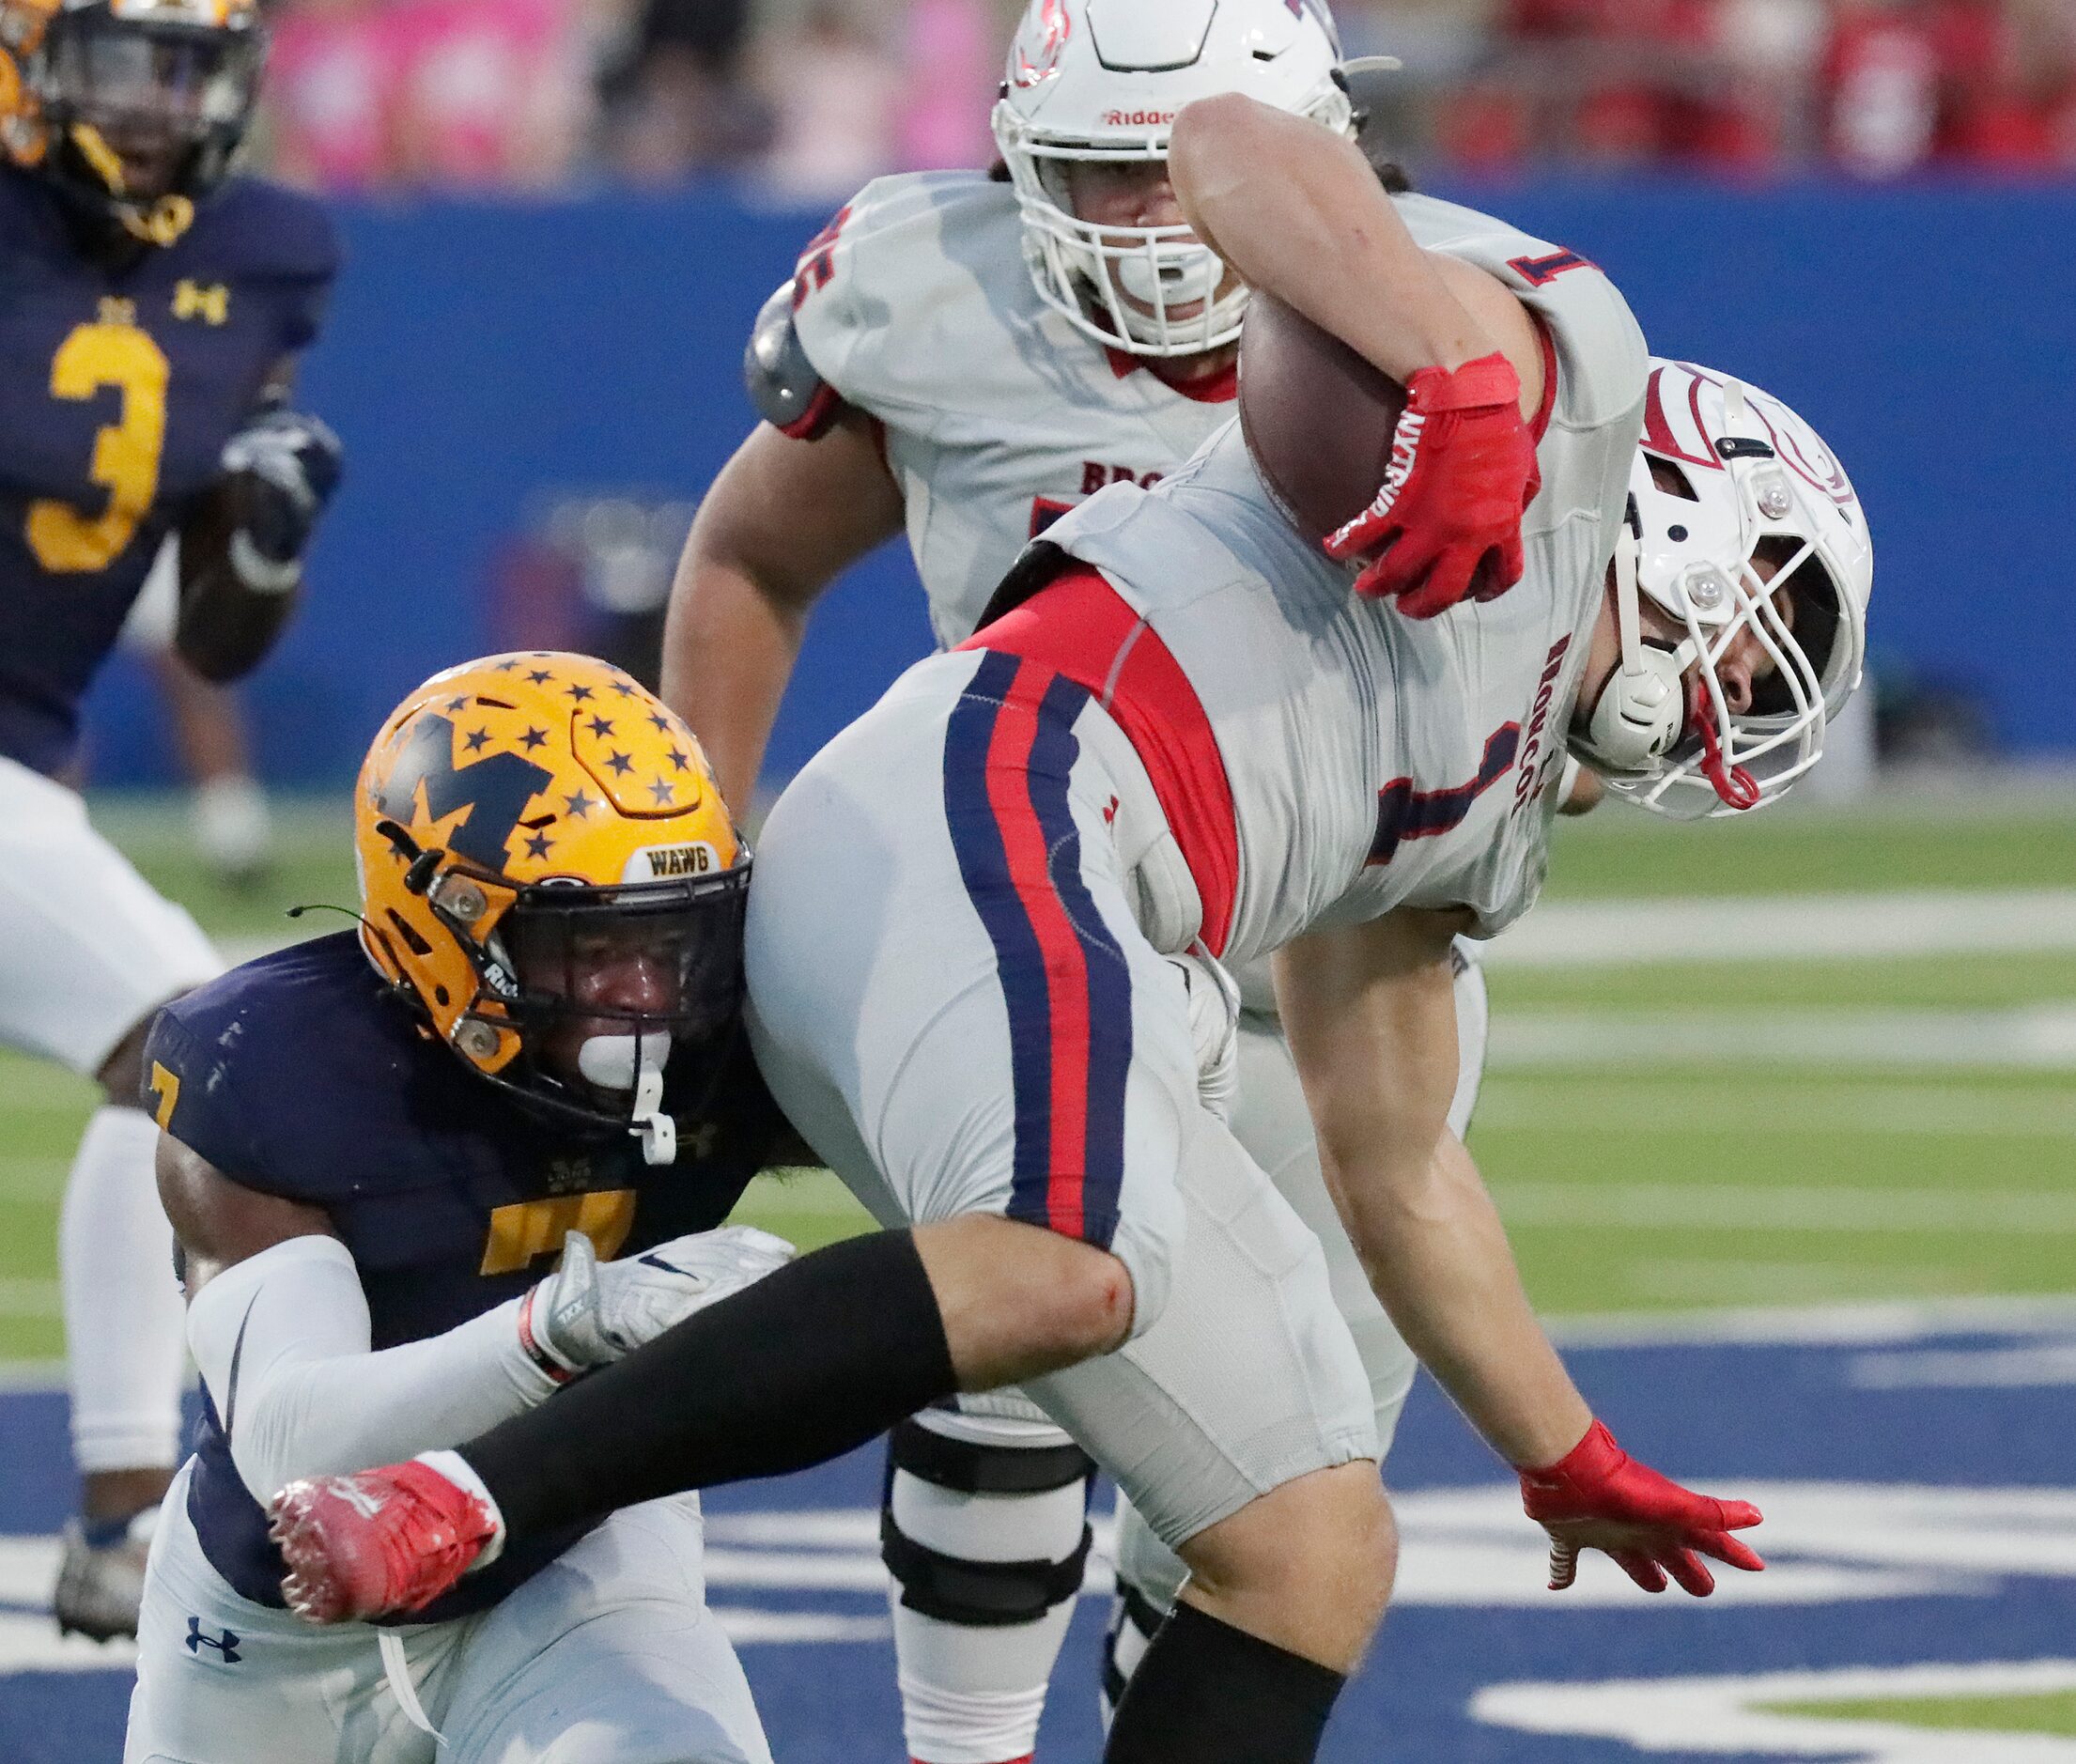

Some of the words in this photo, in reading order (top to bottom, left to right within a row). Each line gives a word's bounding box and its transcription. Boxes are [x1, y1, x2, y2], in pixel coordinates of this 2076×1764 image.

[25, 323, 171, 573] 3
[1360, 720, 1522, 868] 1
[645, 845, 710, 876] WAWG
[150, 1059, 181, 1133] 7
